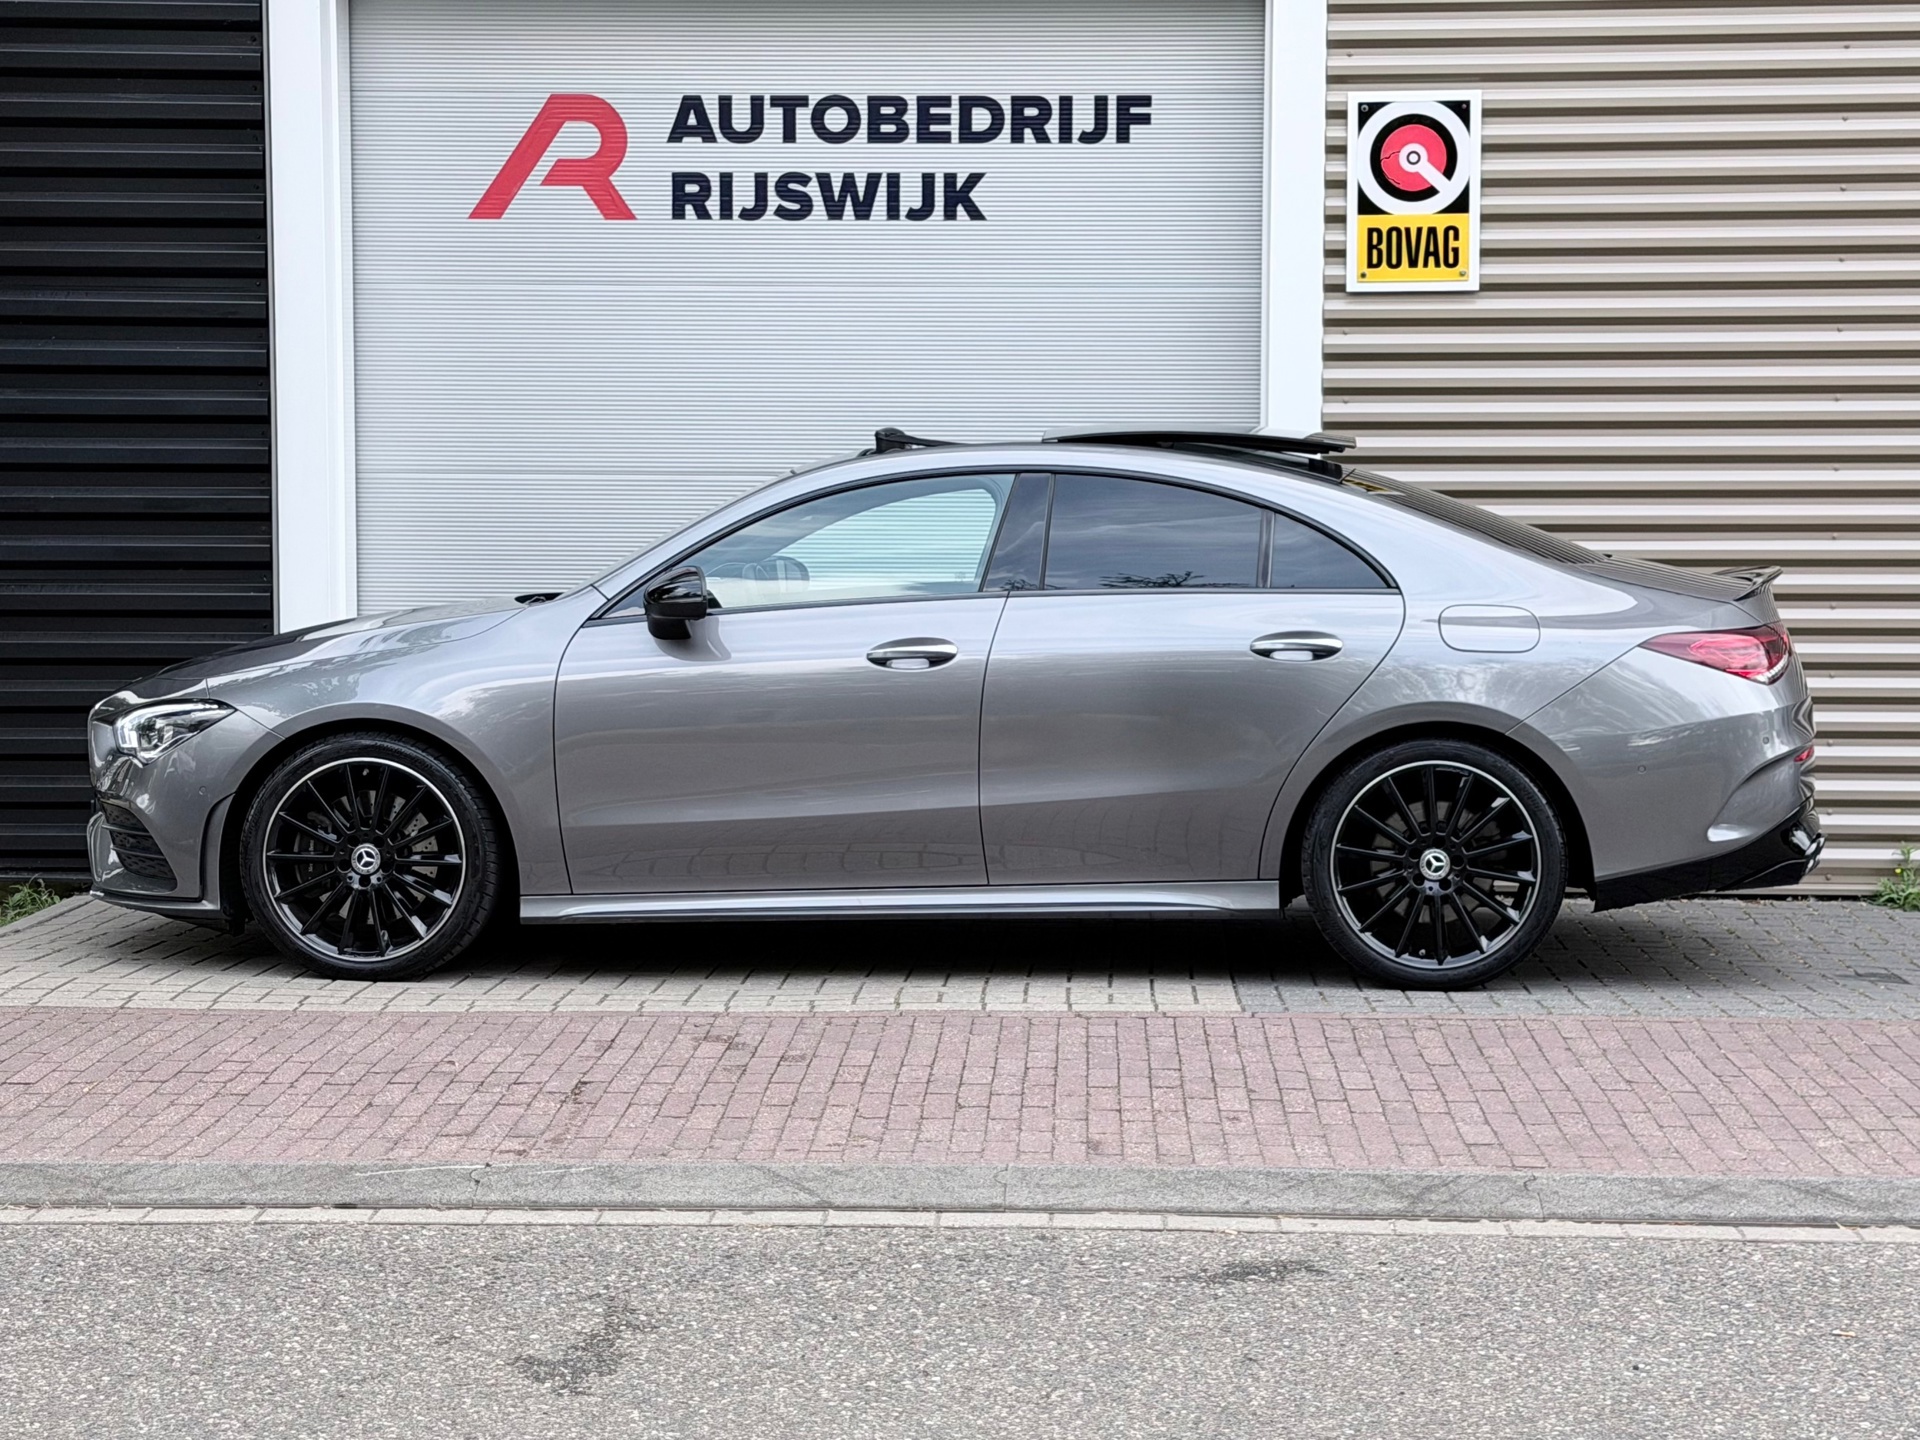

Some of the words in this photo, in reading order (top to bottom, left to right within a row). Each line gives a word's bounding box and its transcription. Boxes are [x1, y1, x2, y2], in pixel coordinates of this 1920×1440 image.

[667, 94, 1153, 144] AUTOBEDRIJF
[670, 171, 987, 222] RIJSWIJK
[1366, 225, 1460, 269] BOVAG
